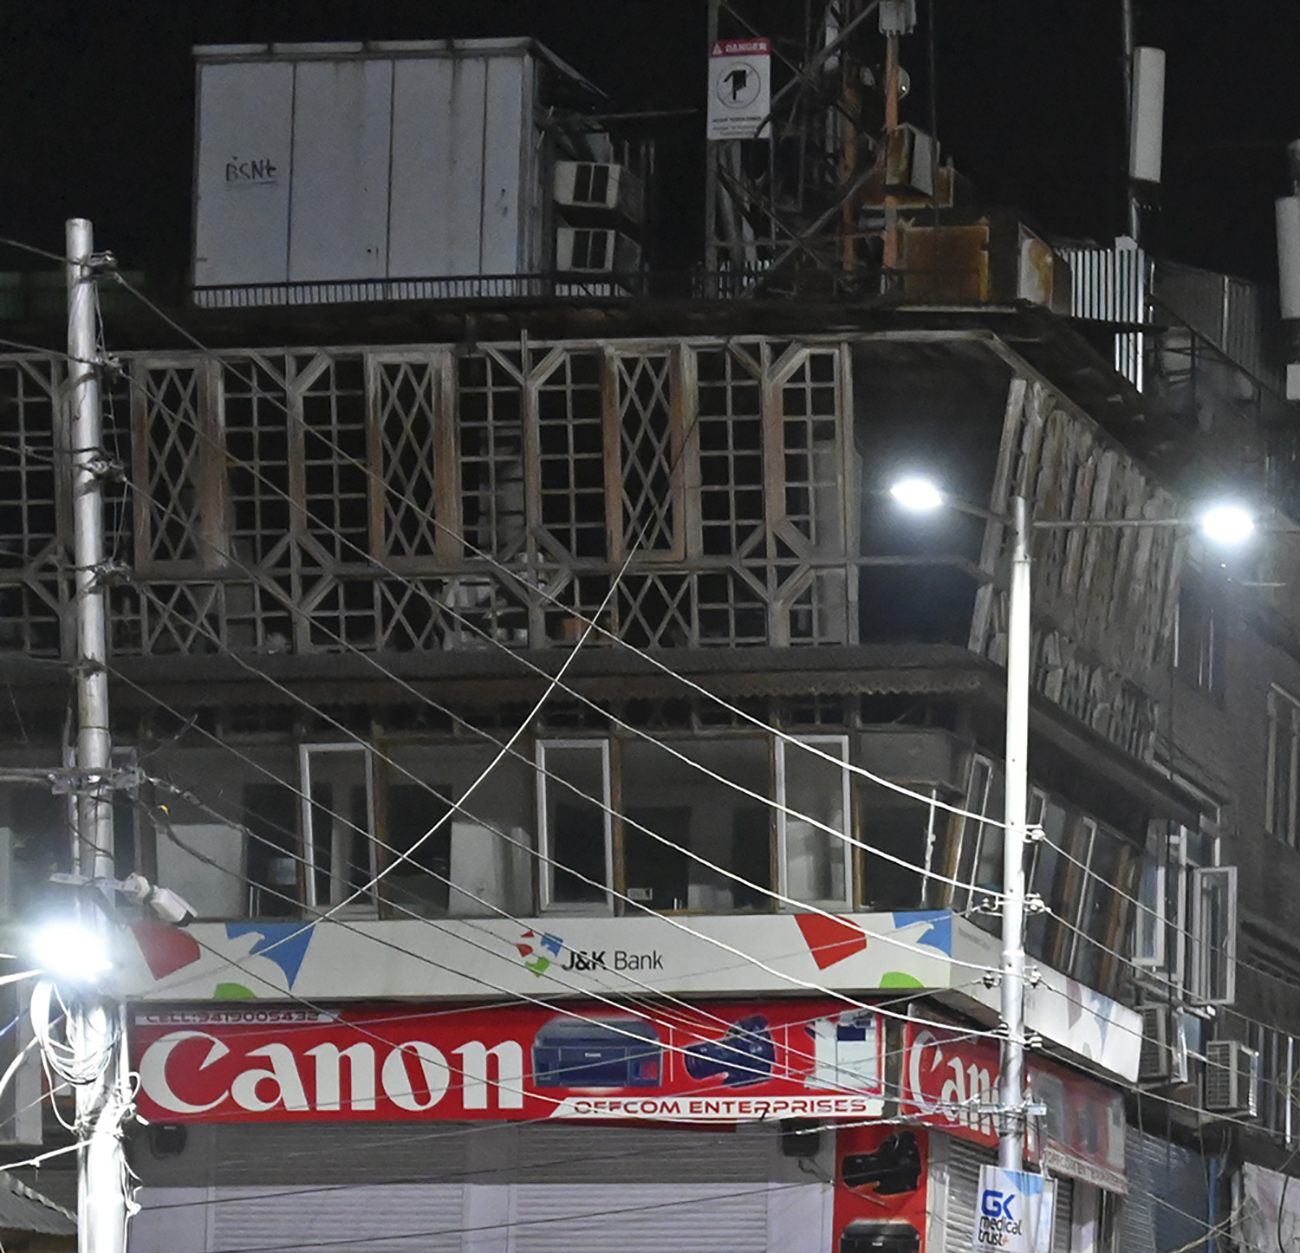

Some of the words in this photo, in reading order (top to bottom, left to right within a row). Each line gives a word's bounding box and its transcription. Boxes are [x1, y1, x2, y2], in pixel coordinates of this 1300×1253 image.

[562, 951, 606, 971] J&K
[614, 950, 663, 970] Bank
[139, 1030, 524, 1114] Canon
[575, 1100, 682, 1114] OFFCOM
[689, 1100, 867, 1113] ENTERPRISES
[981, 1190, 1015, 1220] GK
[980, 1216, 1022, 1236] medical
